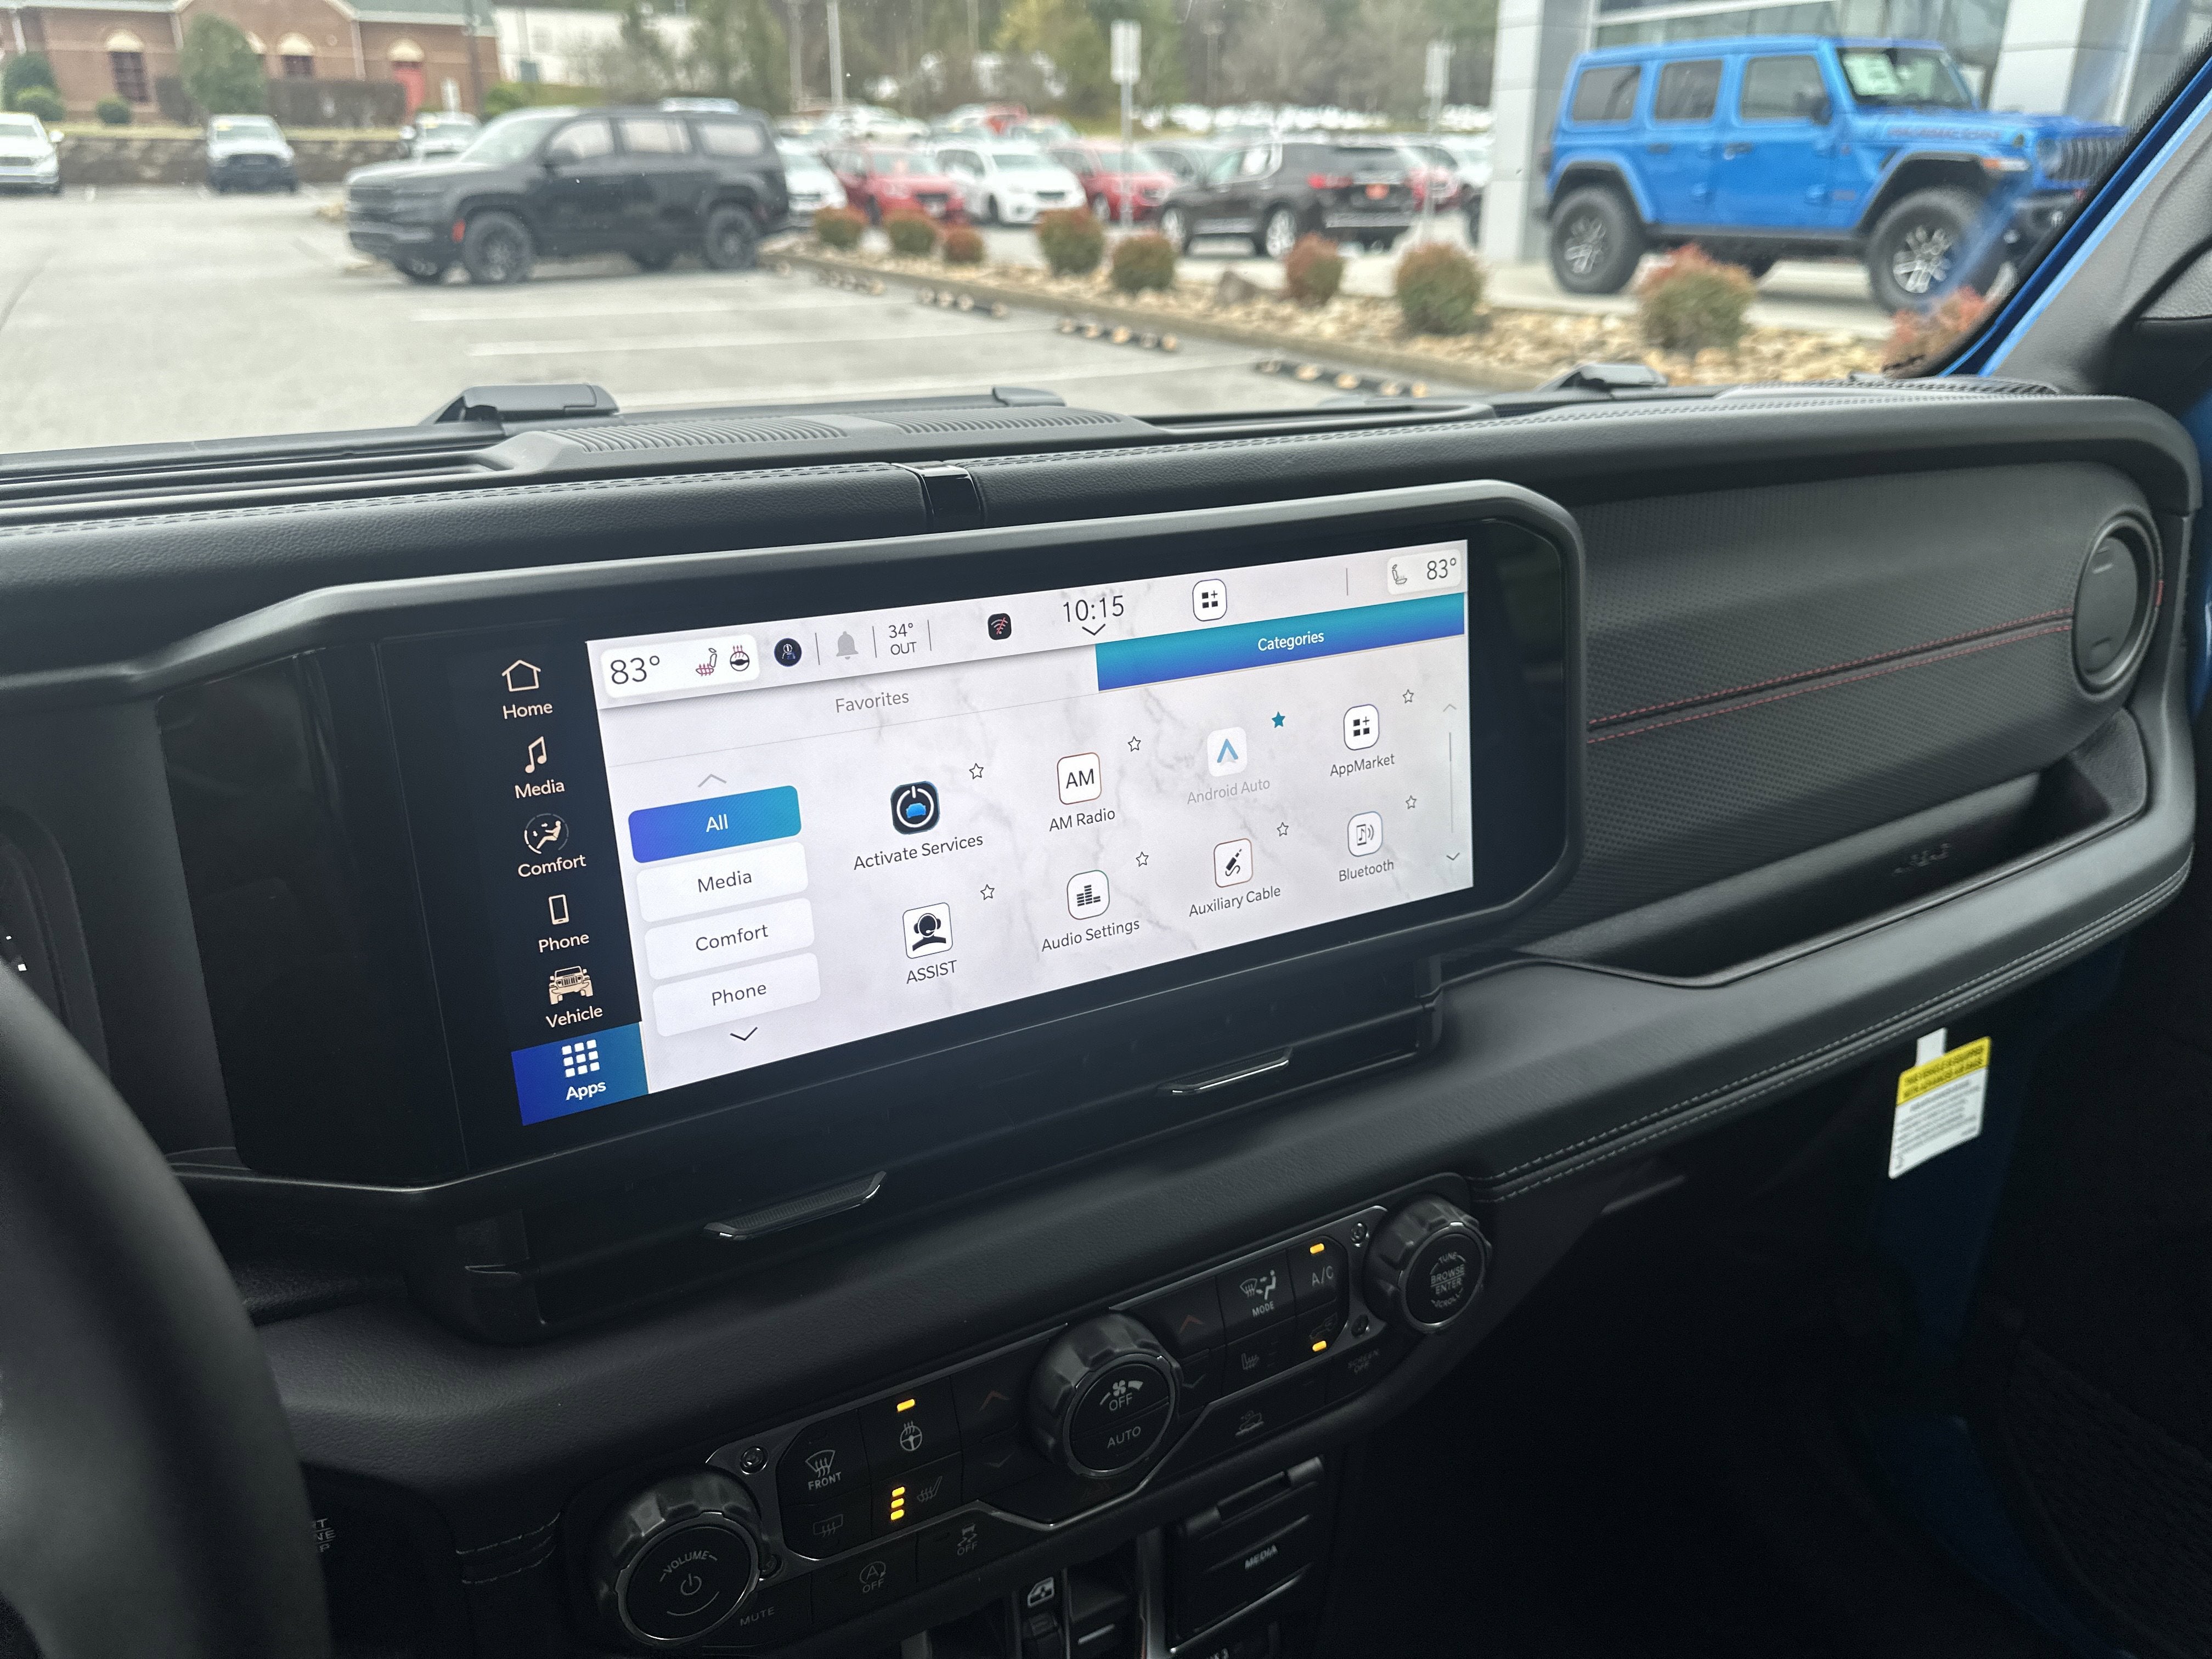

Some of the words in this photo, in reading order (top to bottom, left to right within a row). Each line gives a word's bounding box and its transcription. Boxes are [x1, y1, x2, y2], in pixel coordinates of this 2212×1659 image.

[1426, 556, 1457, 581] 83°
[1063, 594, 1125, 624] 10:15
[889, 622, 913, 640] 34°
[1257, 629, 1324, 653] Categories
[890, 641, 917, 656] OUT
[610, 655, 660, 685] 83°
[502, 702, 554, 719] Home
[836, 691, 910, 713] Favorites
[1330, 753, 1395, 777] AppMarket
[514, 780, 565, 799] Media
[1066, 769, 1095, 789] AM
[1187, 783, 1238, 804] Android
[1241, 778, 1271, 794] Auto
[706, 814, 729, 833] All
[1049, 815, 1073, 832] AM
[1076, 808, 1116, 827] Radio
[854, 846, 918, 871] Activate
[922, 834, 984, 856] Services
[518, 854, 586, 877] Comfort
[1339, 859, 1394, 882] Bluetooth
[697, 870, 753, 893] Media
[1189, 893, 1243, 917] Auxiliary
[1245, 885, 1281, 902] Cable
[538, 932, 590, 953] Phone
[695, 924, 769, 952] Comfort
[1041, 932, 1082, 952] Audio
[1085, 919, 1140, 942] Settings
[906, 960, 957, 984] ASSIST
[712, 982, 767, 1007] Phone
[546, 1005, 603, 1028] Vehicle
[565, 1080, 607, 1101] Apps
[1438, 1251, 1457, 1263] TUNE
[1311, 1265, 1334, 1286] A/C
[1431, 1264, 1465, 1284] BROWSE
[1435, 1278, 1462, 1295] ENTER
[1252, 1301, 1274, 1316] MODE
[1109, 1393, 1133, 1412] OFF
[1107, 1426, 1141, 1448] AUTO
[808, 1471, 842, 1490] FRONT
[957, 1539, 978, 1556] OFF
[1244, 1544, 1278, 1570] MEDIA
[663, 1550, 710, 1574] VOLUME
[862, 1577, 885, 1593] OFF
[740, 1606, 775, 1626] MUTE
